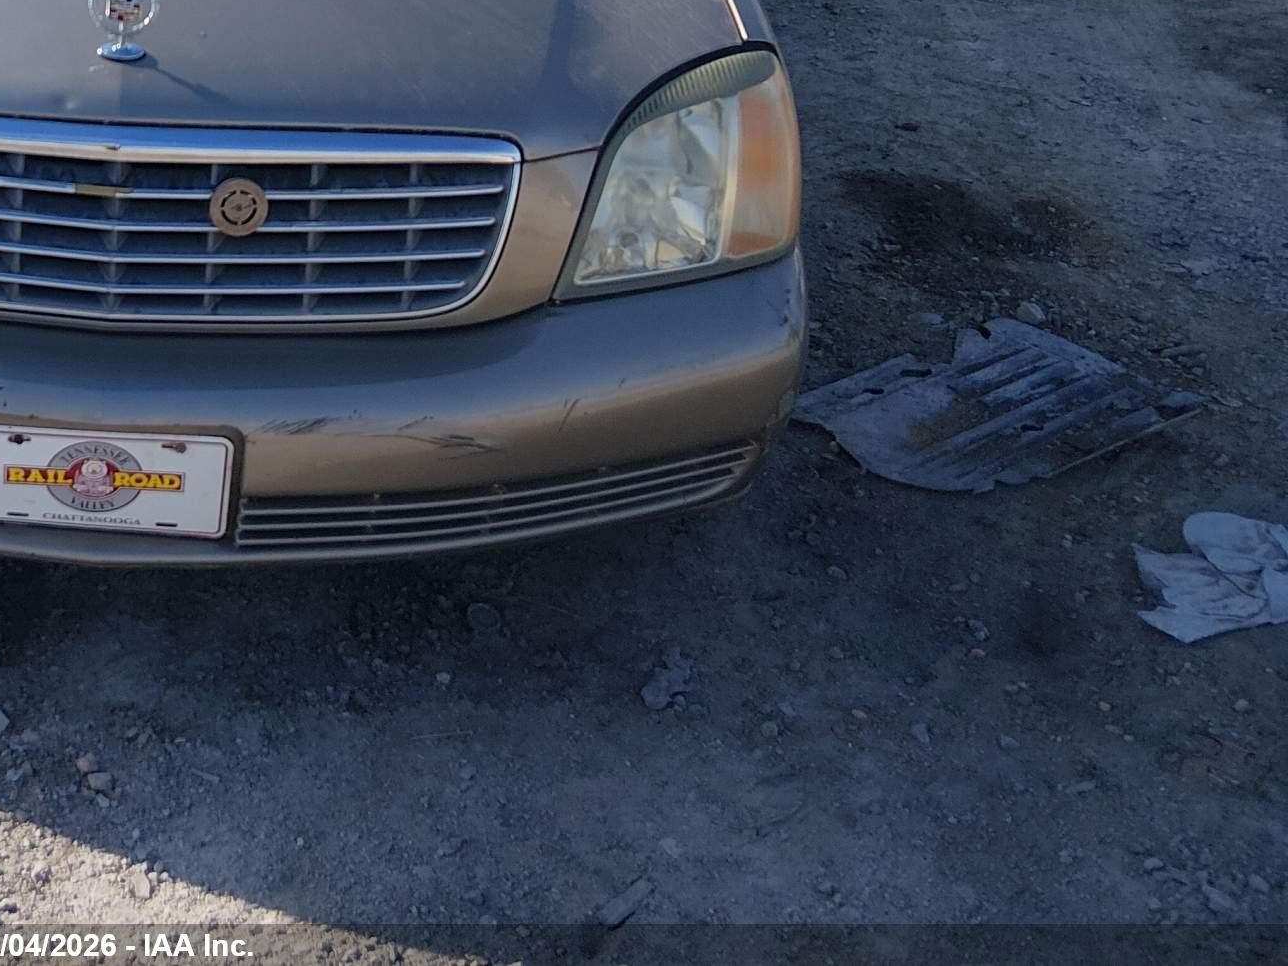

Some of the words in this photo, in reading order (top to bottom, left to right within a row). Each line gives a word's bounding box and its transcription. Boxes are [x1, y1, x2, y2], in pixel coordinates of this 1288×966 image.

[60, 444, 130, 465] TENNESSEE
[7, 467, 72, 483] RAIL
[114, 471, 181, 489] ROAD
[71, 496, 115, 510] VALLEY
[42, 512, 141, 525] CHATTANOOGA
